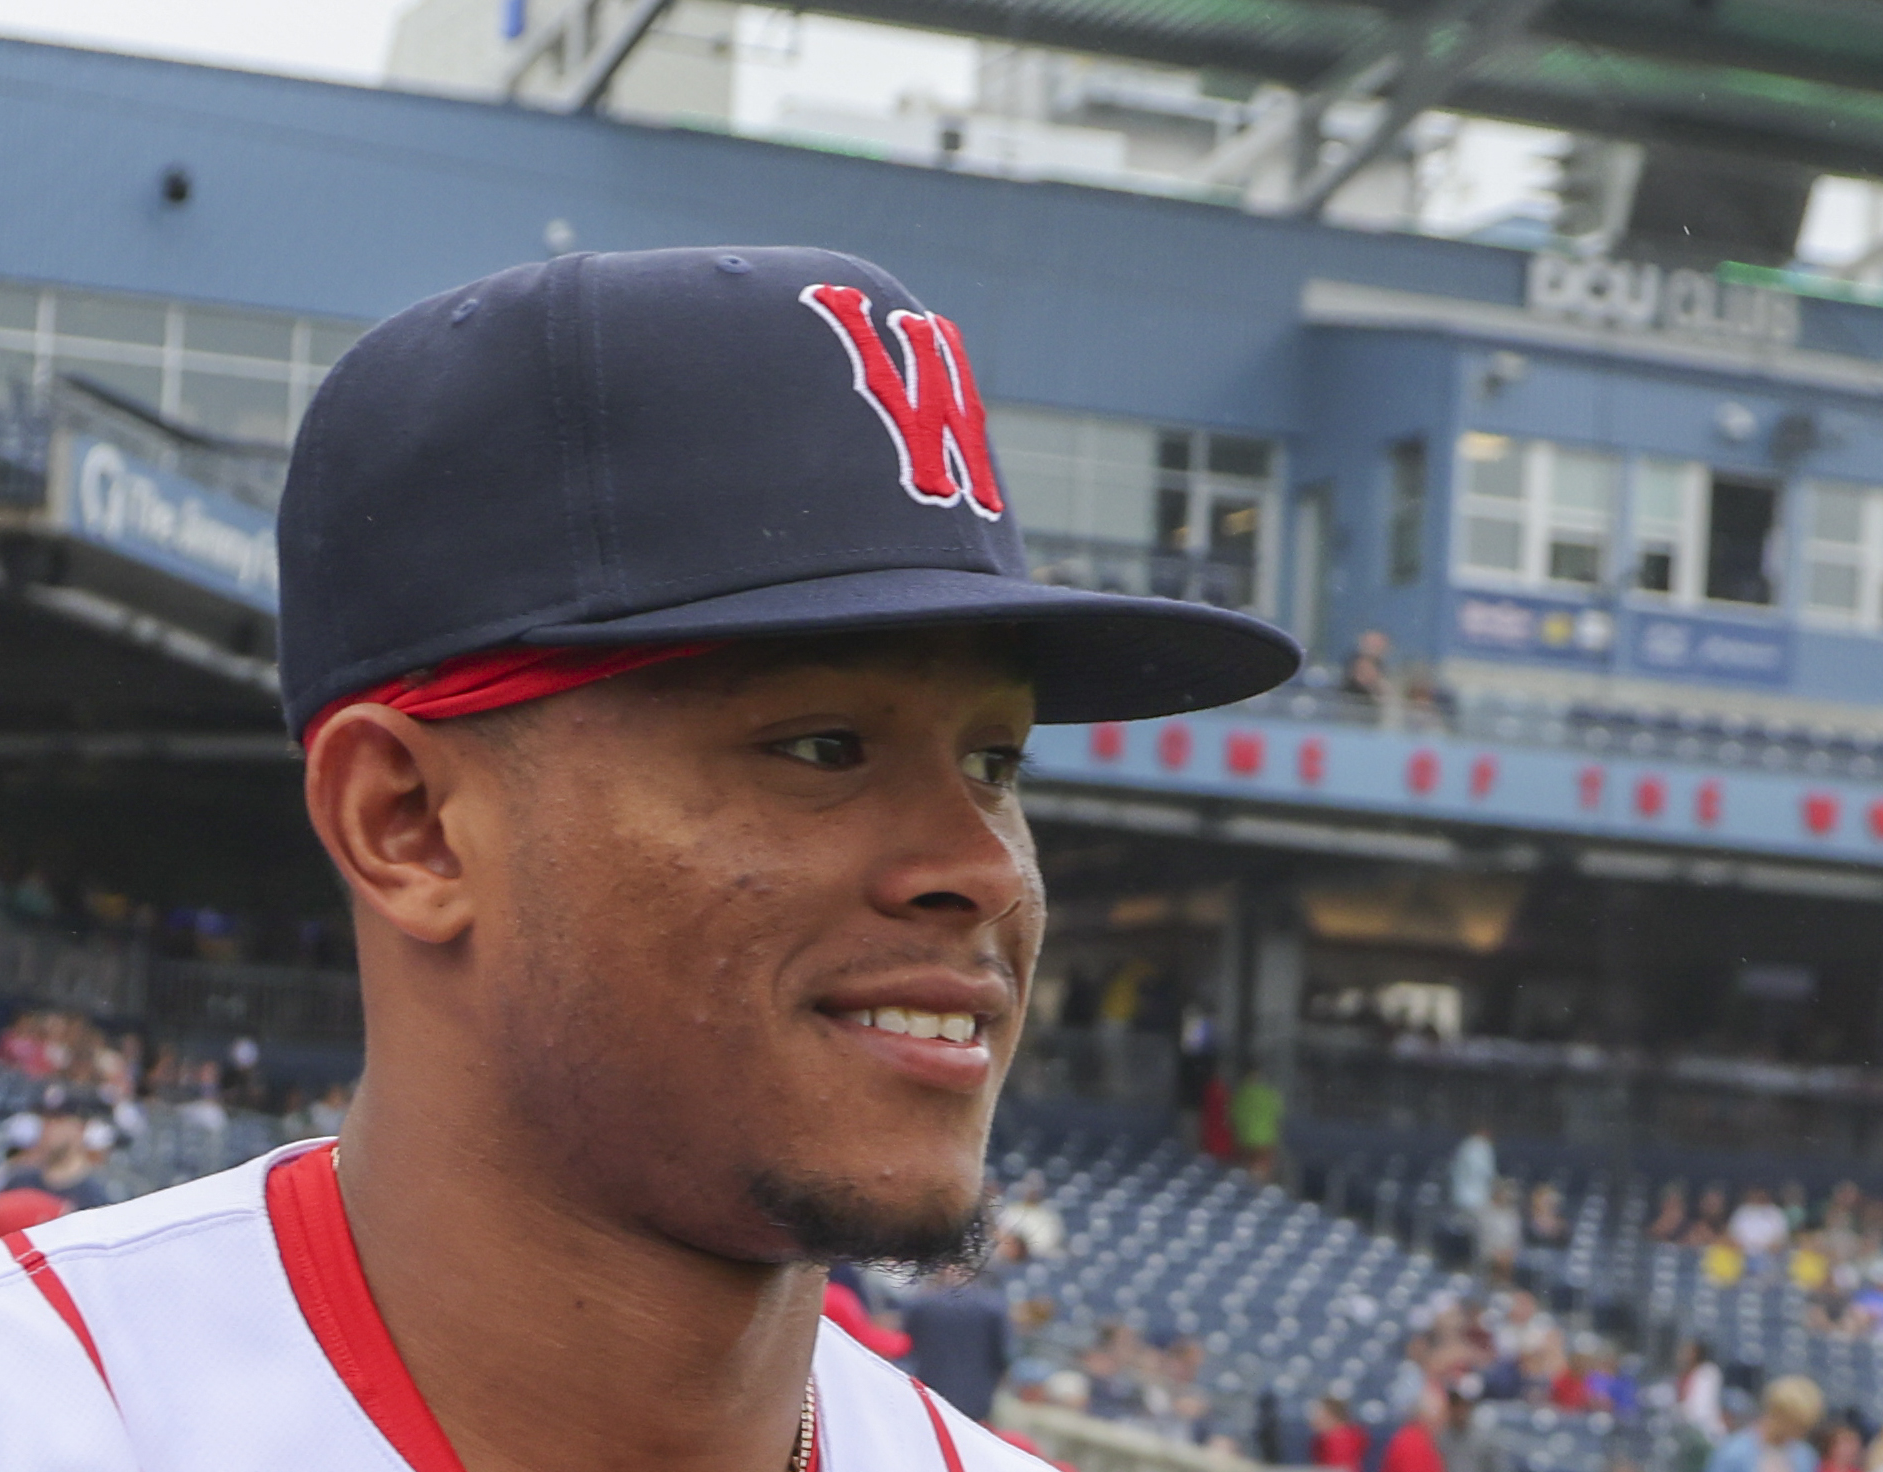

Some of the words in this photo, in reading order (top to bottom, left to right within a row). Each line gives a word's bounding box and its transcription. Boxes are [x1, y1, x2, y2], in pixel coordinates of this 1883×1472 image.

[799, 283, 1005, 523] W
[1088, 718, 1327, 786] HOME
[1405, 749, 1498, 798] OF
[1578, 765, 1724, 827] THE
